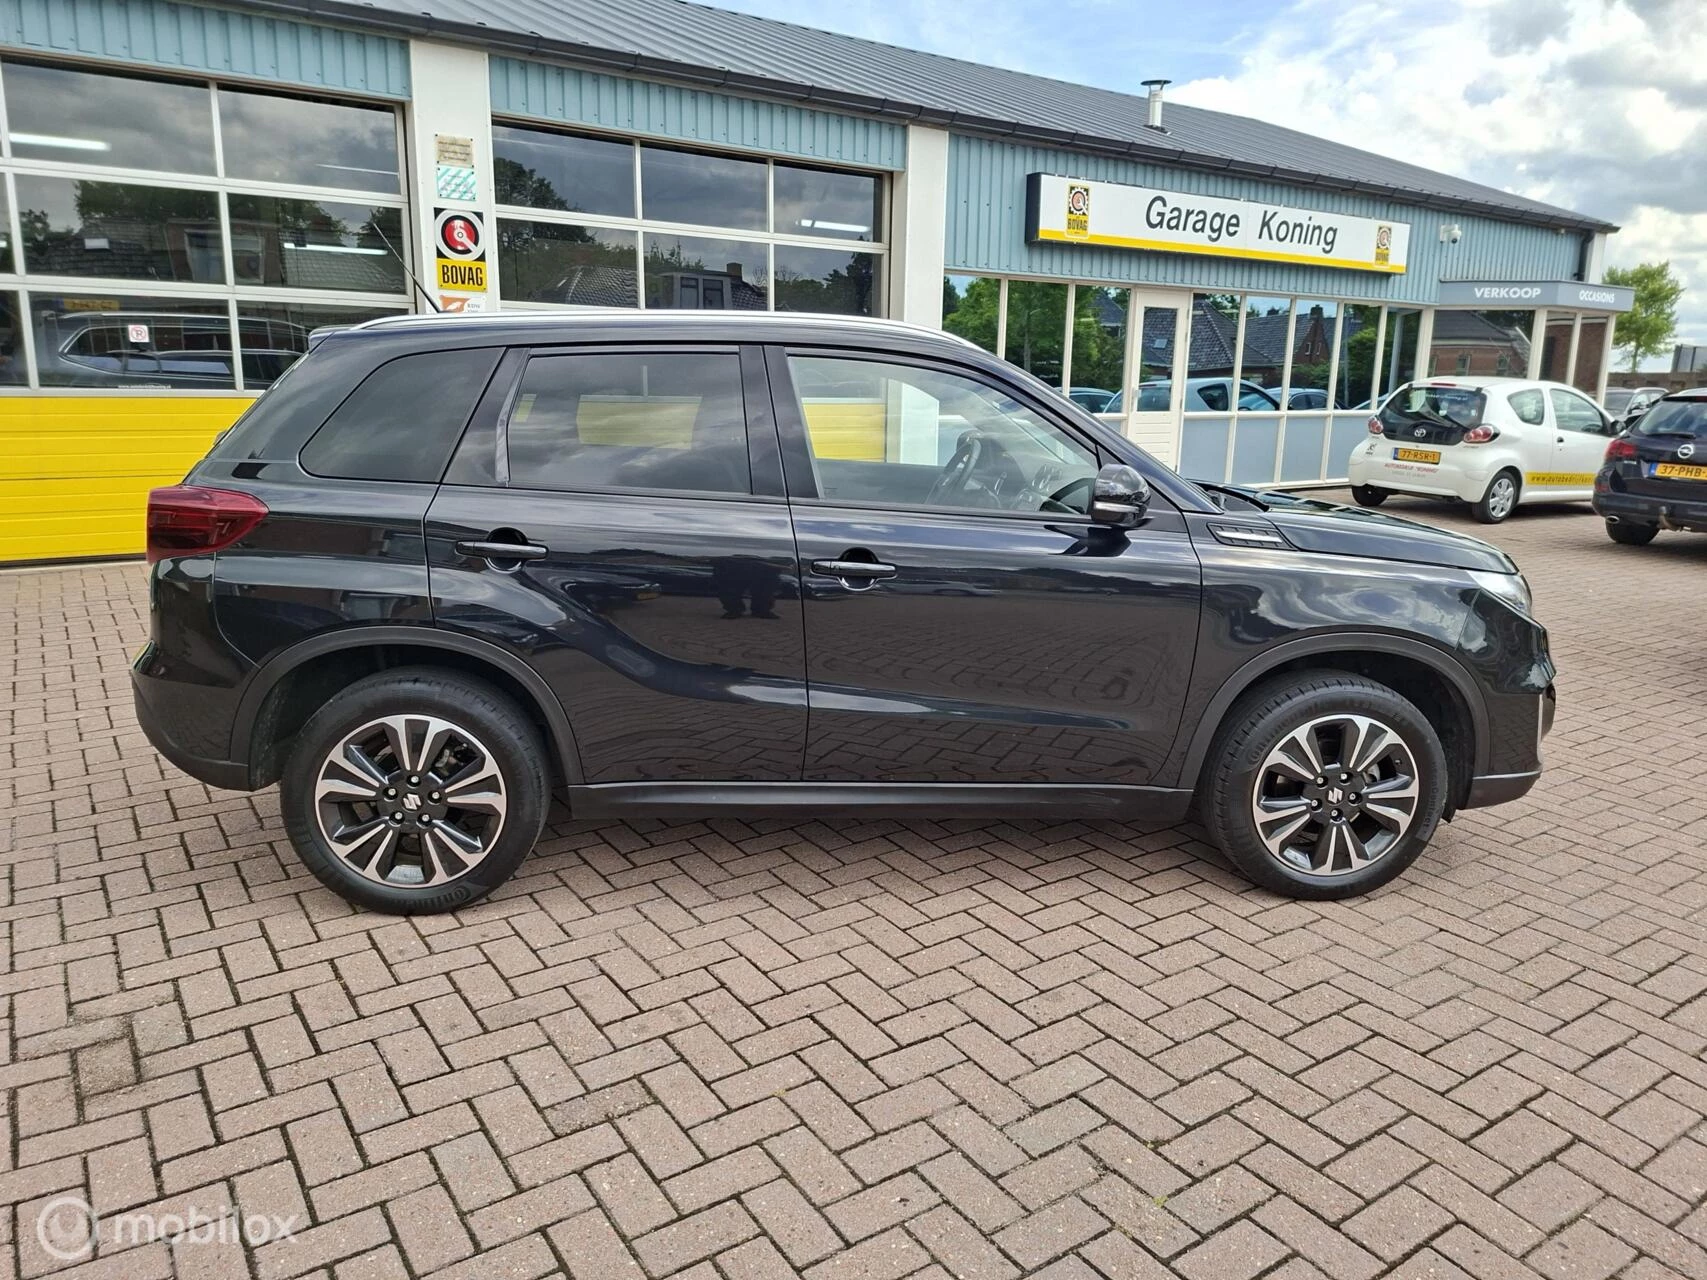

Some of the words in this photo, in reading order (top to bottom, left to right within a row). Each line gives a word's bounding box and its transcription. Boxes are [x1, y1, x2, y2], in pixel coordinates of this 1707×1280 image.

[1146, 195, 1240, 243] Garage
[1258, 210, 1338, 254] Koning
[442, 264, 483, 286] BOVAG
[1474, 287, 1541, 298] VERKOOP
[1578, 289, 1615, 303] OCCASIONS
[1400, 450, 1436, 461] 77-RSR-1
[1662, 465, 1707, 478] 37-PHB-
